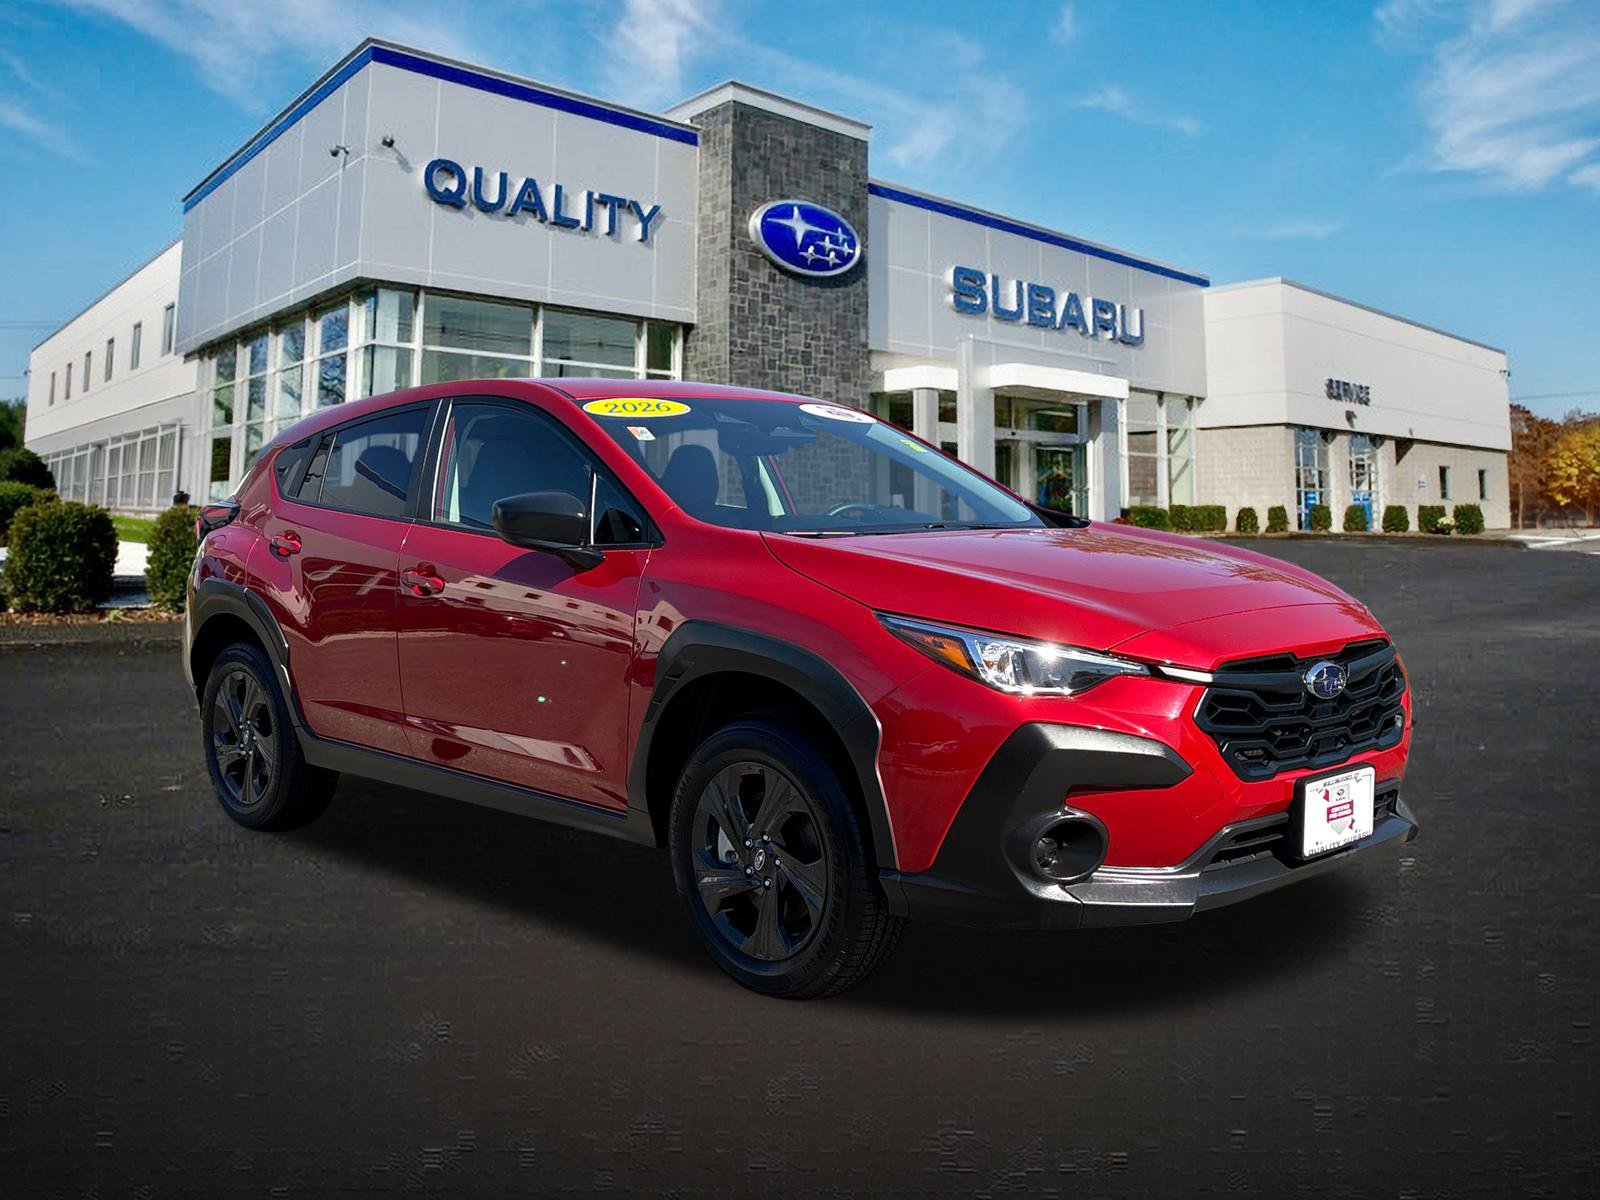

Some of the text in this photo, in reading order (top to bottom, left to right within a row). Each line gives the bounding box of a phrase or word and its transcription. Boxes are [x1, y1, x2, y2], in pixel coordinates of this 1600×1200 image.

[423, 158, 662, 243] QUALITY
[951, 265, 1145, 346] SUBARU
[604, 402, 671, 413] 2026
[1325, 378, 1371, 407] SERVICE
